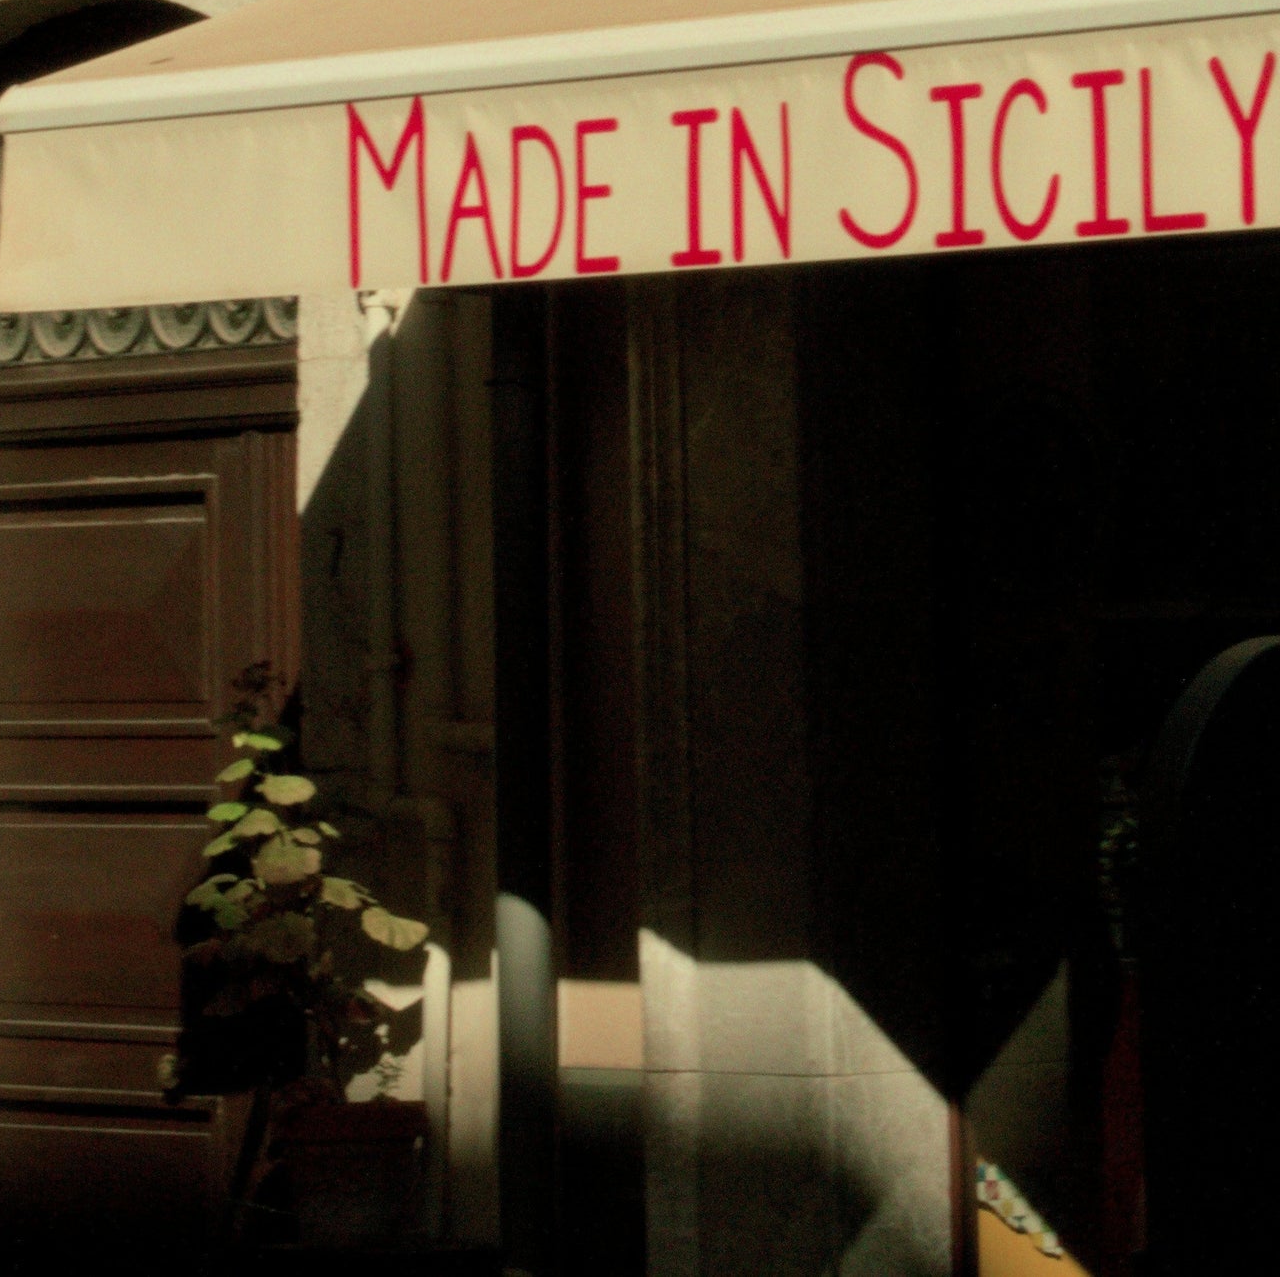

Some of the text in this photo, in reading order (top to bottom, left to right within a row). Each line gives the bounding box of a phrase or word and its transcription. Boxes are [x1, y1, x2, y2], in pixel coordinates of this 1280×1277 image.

[345, 50, 1277, 290] MADE IN SICILY
